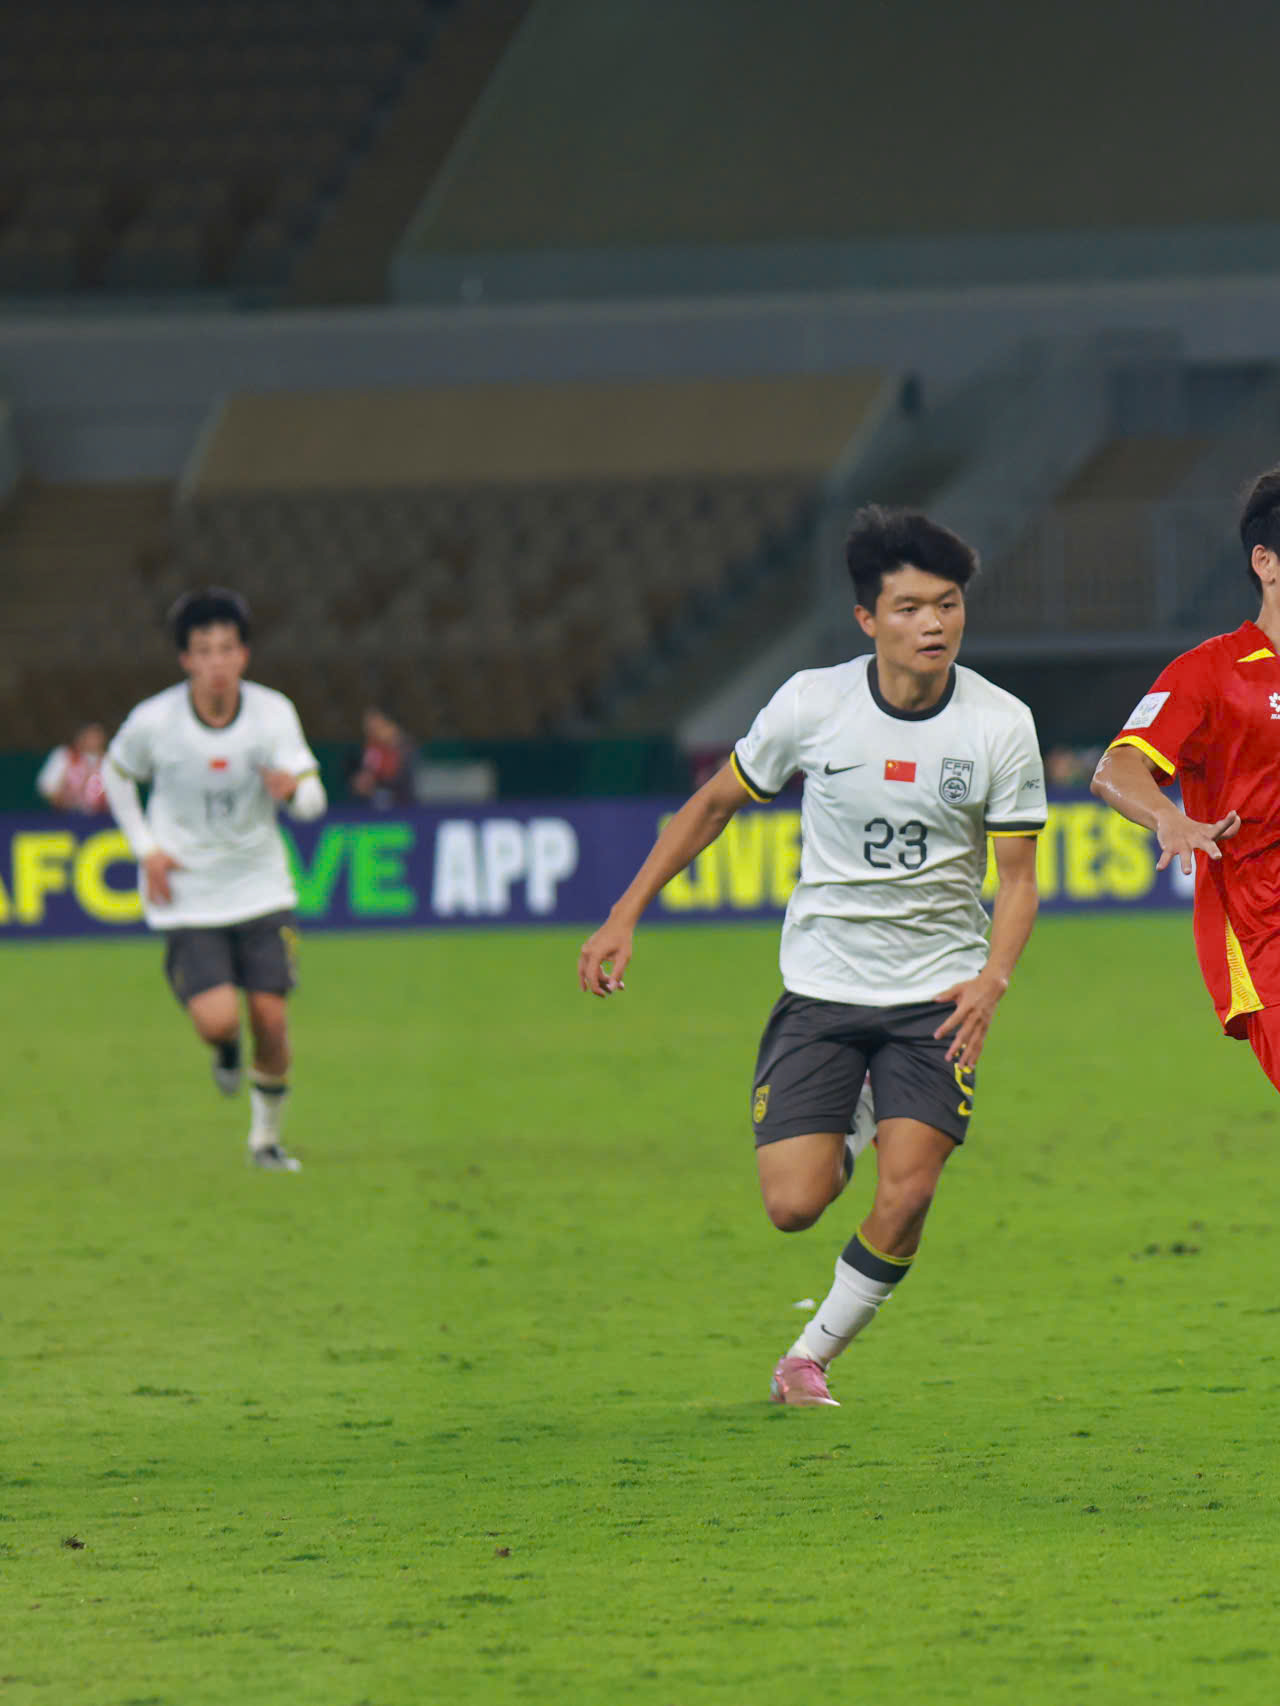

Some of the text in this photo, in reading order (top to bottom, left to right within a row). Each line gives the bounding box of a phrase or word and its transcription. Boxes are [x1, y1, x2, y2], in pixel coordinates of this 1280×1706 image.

[0, 829, 146, 926] FC
[432, 817, 578, 917] APP
[864, 817, 928, 870] 23
